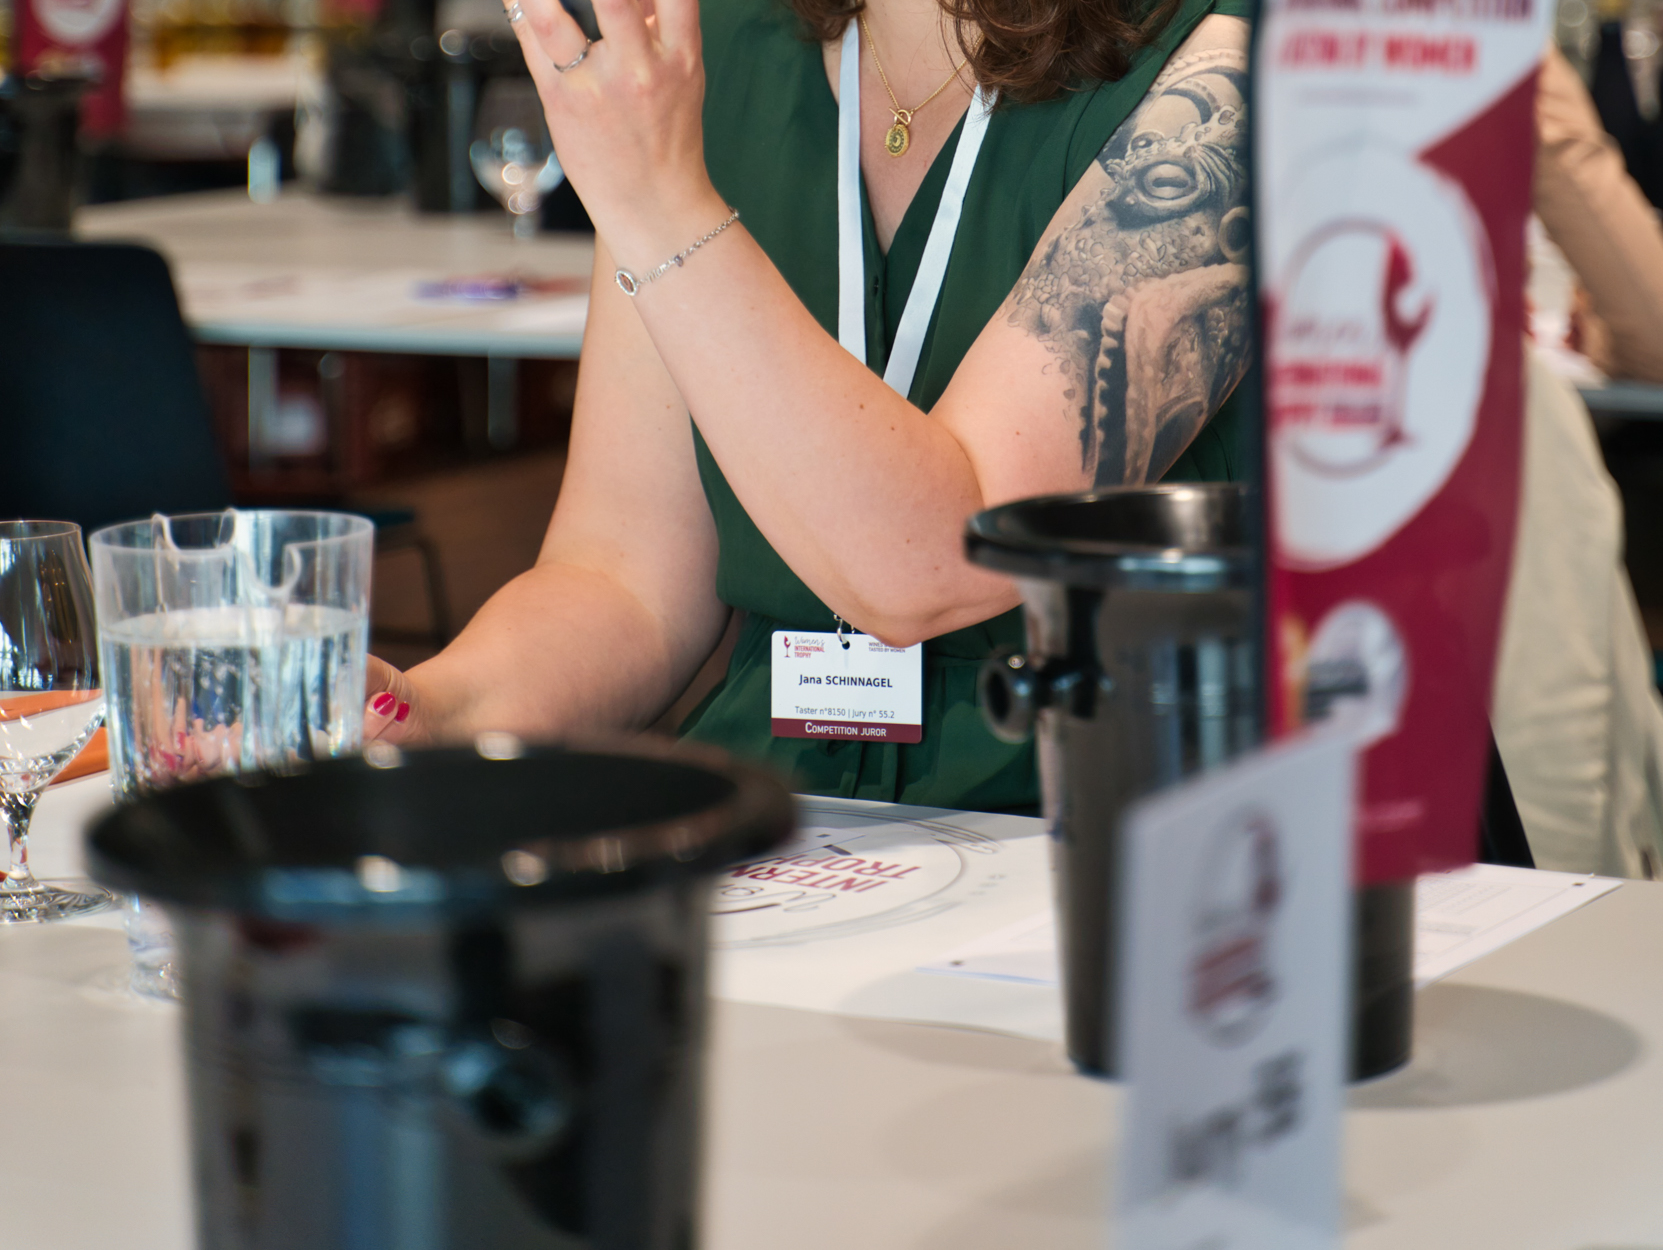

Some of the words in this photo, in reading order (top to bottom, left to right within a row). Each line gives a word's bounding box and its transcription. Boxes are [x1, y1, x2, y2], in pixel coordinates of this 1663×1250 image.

[799, 674, 822, 686] Jana
[825, 675, 893, 688] SCHINNAGEL
[795, 705, 817, 715] Taster
[852, 709, 866, 719] Jury
[879, 710, 895, 719] 55.2
[805, 722, 858, 735] COMPETITION
